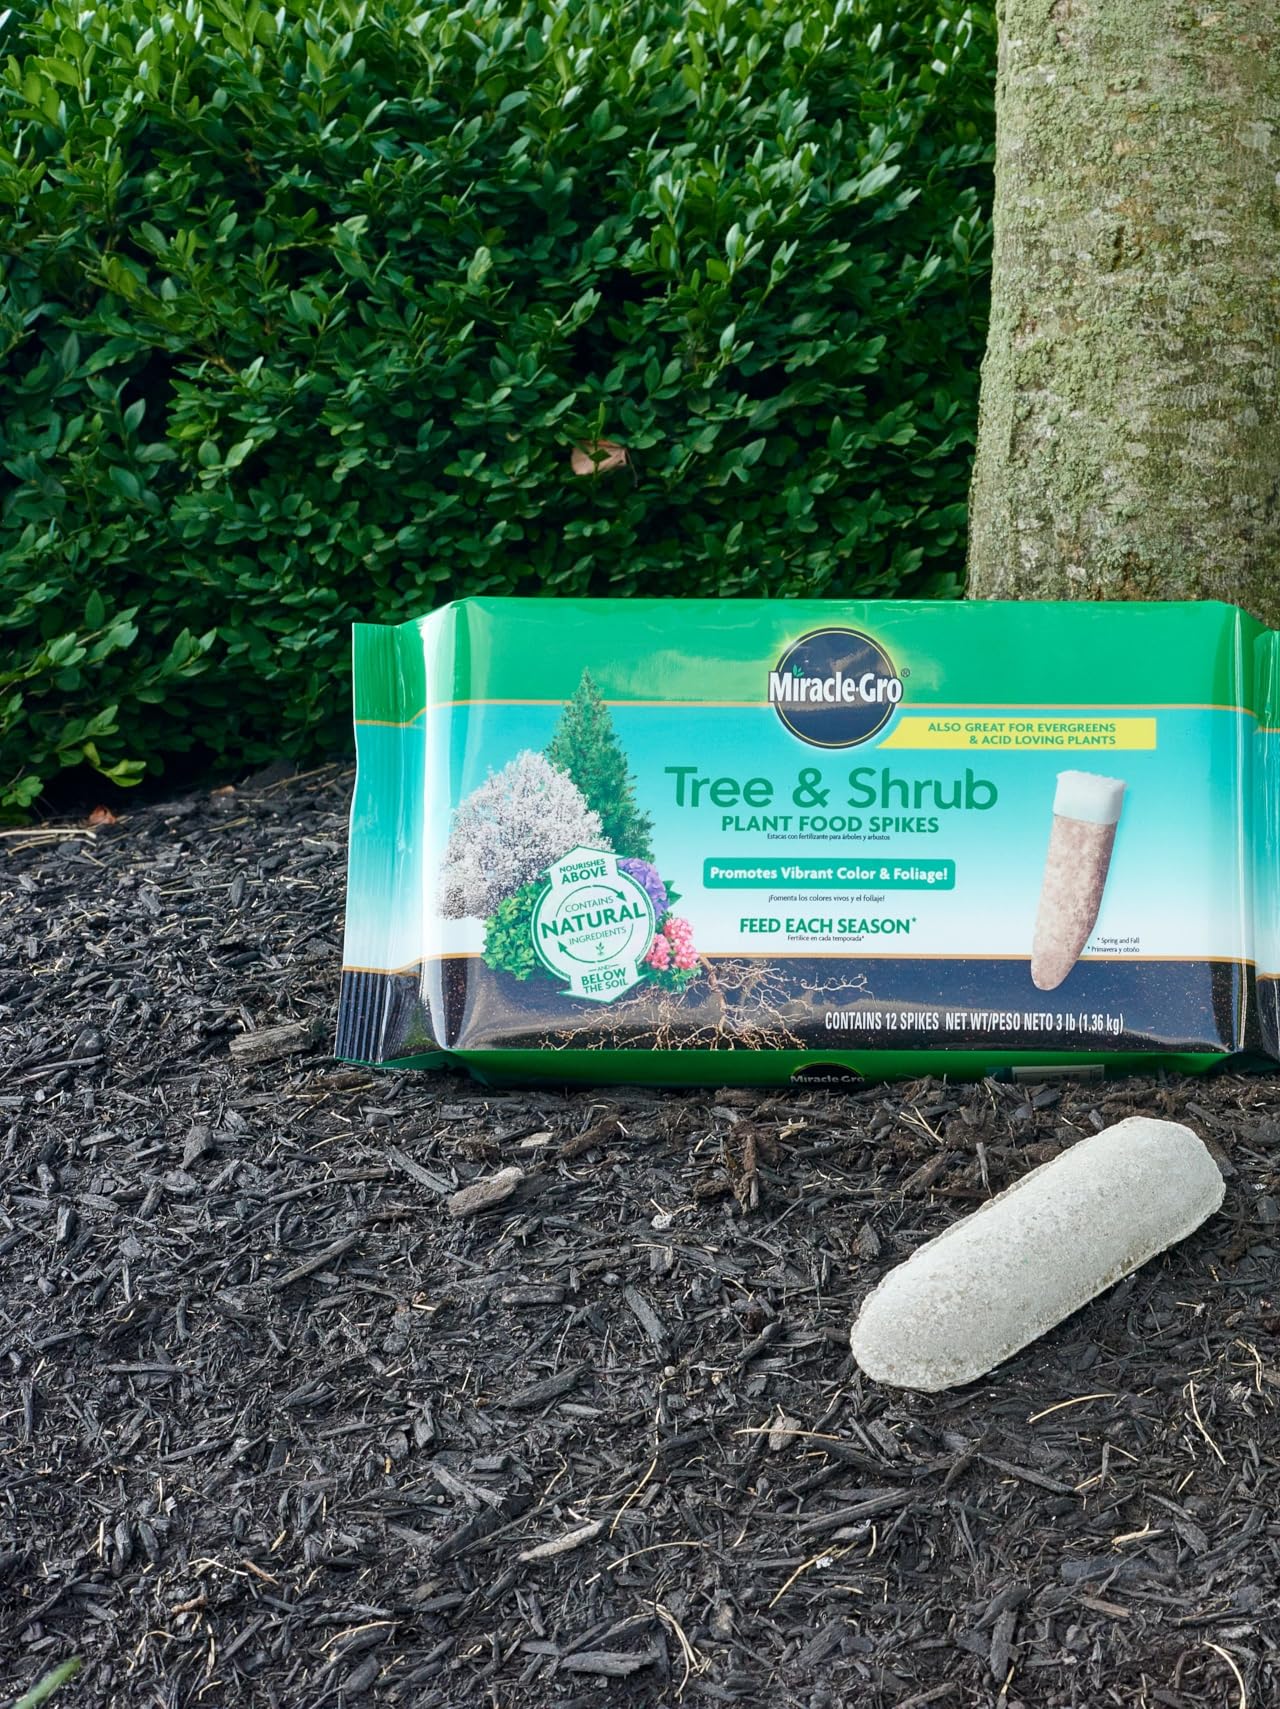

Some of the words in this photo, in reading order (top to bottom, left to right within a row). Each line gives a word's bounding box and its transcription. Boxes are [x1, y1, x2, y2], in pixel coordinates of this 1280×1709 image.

[928, 722, 961, 732] ALSO
[965, 722, 1005, 732] GREAT
[1009, 723, 1034, 732] FOR
[1037, 723, 1116, 733] EVERGREENS
[969, 735, 978, 745] &
[981, 735, 1012, 745] ACID
[1015, 735, 1065, 745] LOVING
[1068, 735, 1116, 745] PLANTS
[664, 766, 774, 807] Tree
[792, 767, 830, 808] &
[847, 767, 998, 810] Shrub
[722, 816, 793, 832] PLANT
[799, 816, 862, 832] FOOD
[869, 817, 939, 833] SPIKES
[559, 858, 605, 873] NOURISHES
[561, 866, 608, 884] ABOVE
[710, 867, 778, 879] Promotes
[781, 867, 834, 880] Vibrant
[837, 867, 876, 880] Color
[879, 868, 890, 881] &
[893, 868, 948, 884] Foliage!
[565, 896, 614, 913] CONTAINS
[863, 894, 885, 903] follaje!
[541, 902, 646, 939] NATURAL
[740, 918, 781, 933] FEED
[786, 918, 833, 933] EACH
[569, 927, 627, 945] INGREDIENTS
[581, 968, 627, 986] BELOW
[584, 983, 603, 994] THE
[606, 979, 628, 989] SOIL
[825, 1012, 882, 1029] CONTAINS
[885, 1012, 897, 1029] 12
[900, 1012, 939, 1030] SPIKES
[946, 1013, 967, 1030] NET
[970, 1013, 1021, 1032] WT/PESO
[1024, 1014, 1052, 1030] NETO
[1056, 1014, 1062, 1030] 3
[1065, 1014, 1076, 1031] lb
[1079, 1014, 1104, 1033] (1.36
[1106, 1014, 1124, 1035] kg)
